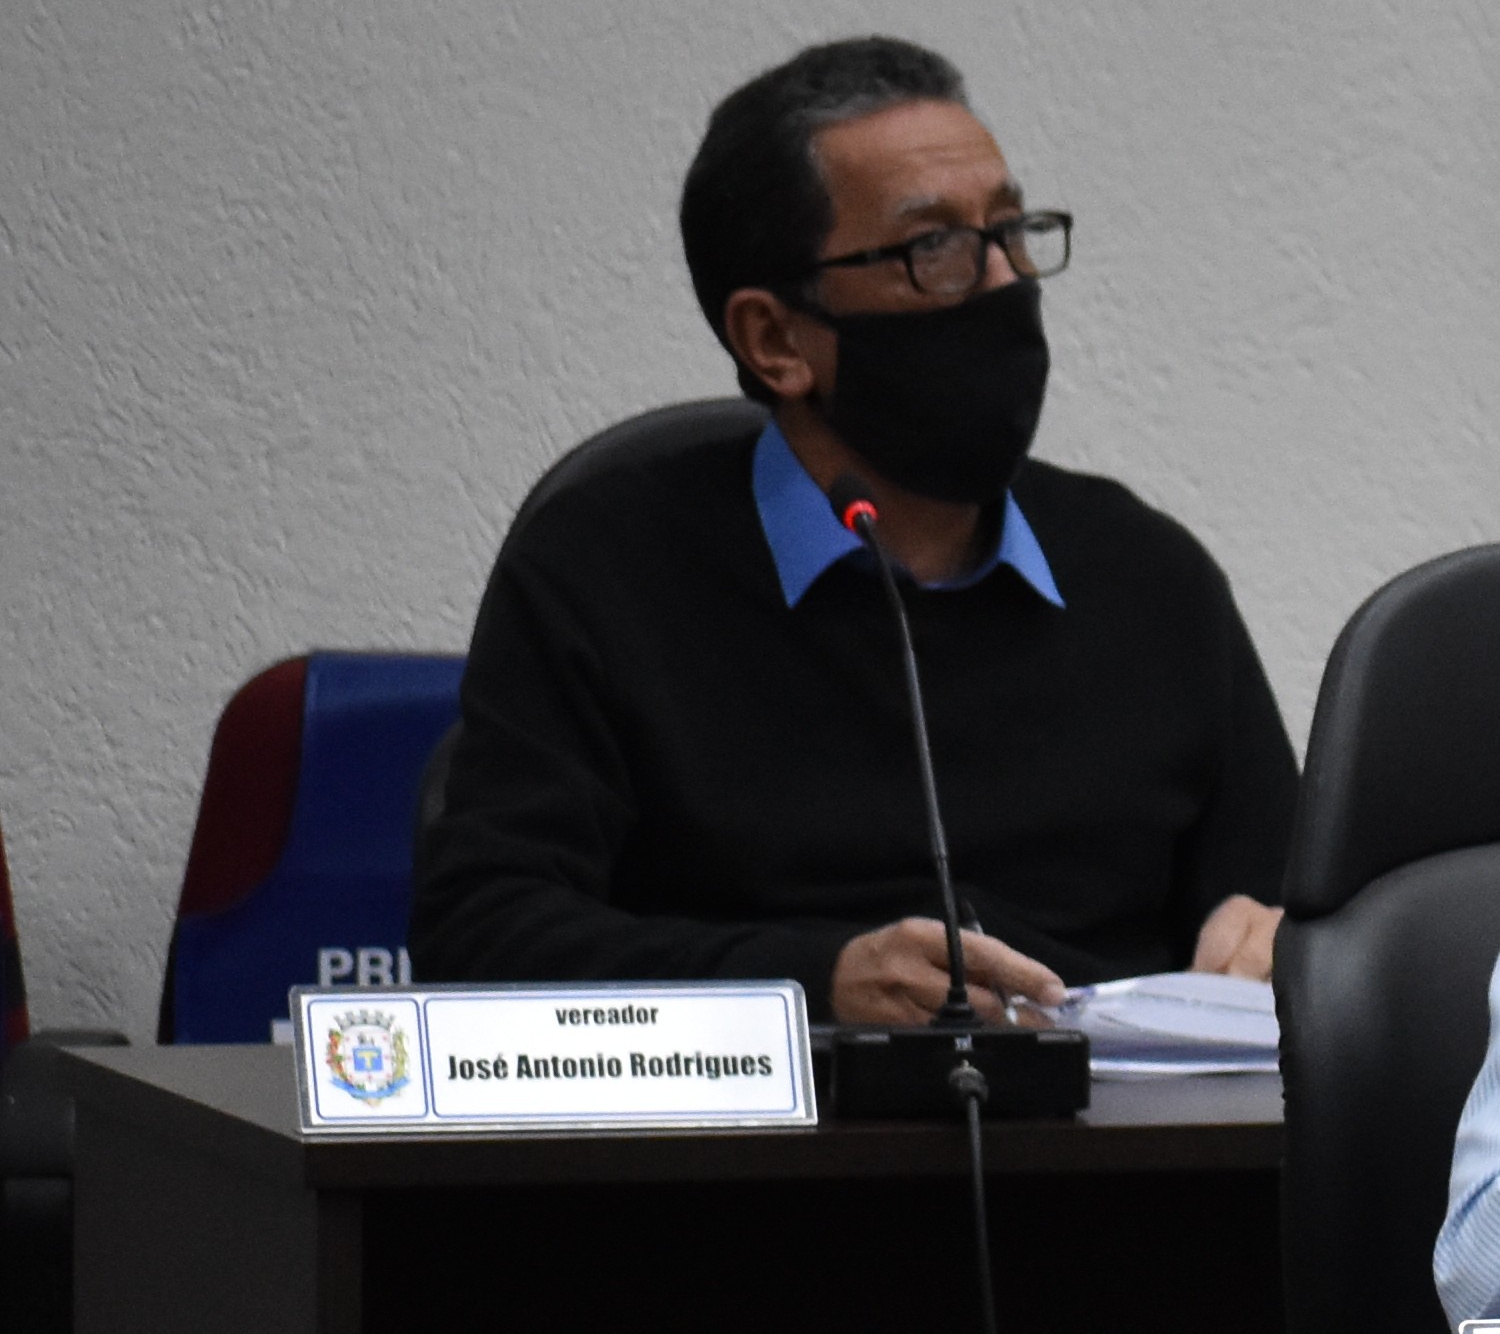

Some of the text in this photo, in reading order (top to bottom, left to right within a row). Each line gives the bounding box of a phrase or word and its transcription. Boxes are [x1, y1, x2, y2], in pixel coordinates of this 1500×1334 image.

[555, 1005, 658, 1026] vereador
[448, 1052, 772, 1081] José Antonio Rodrigues
